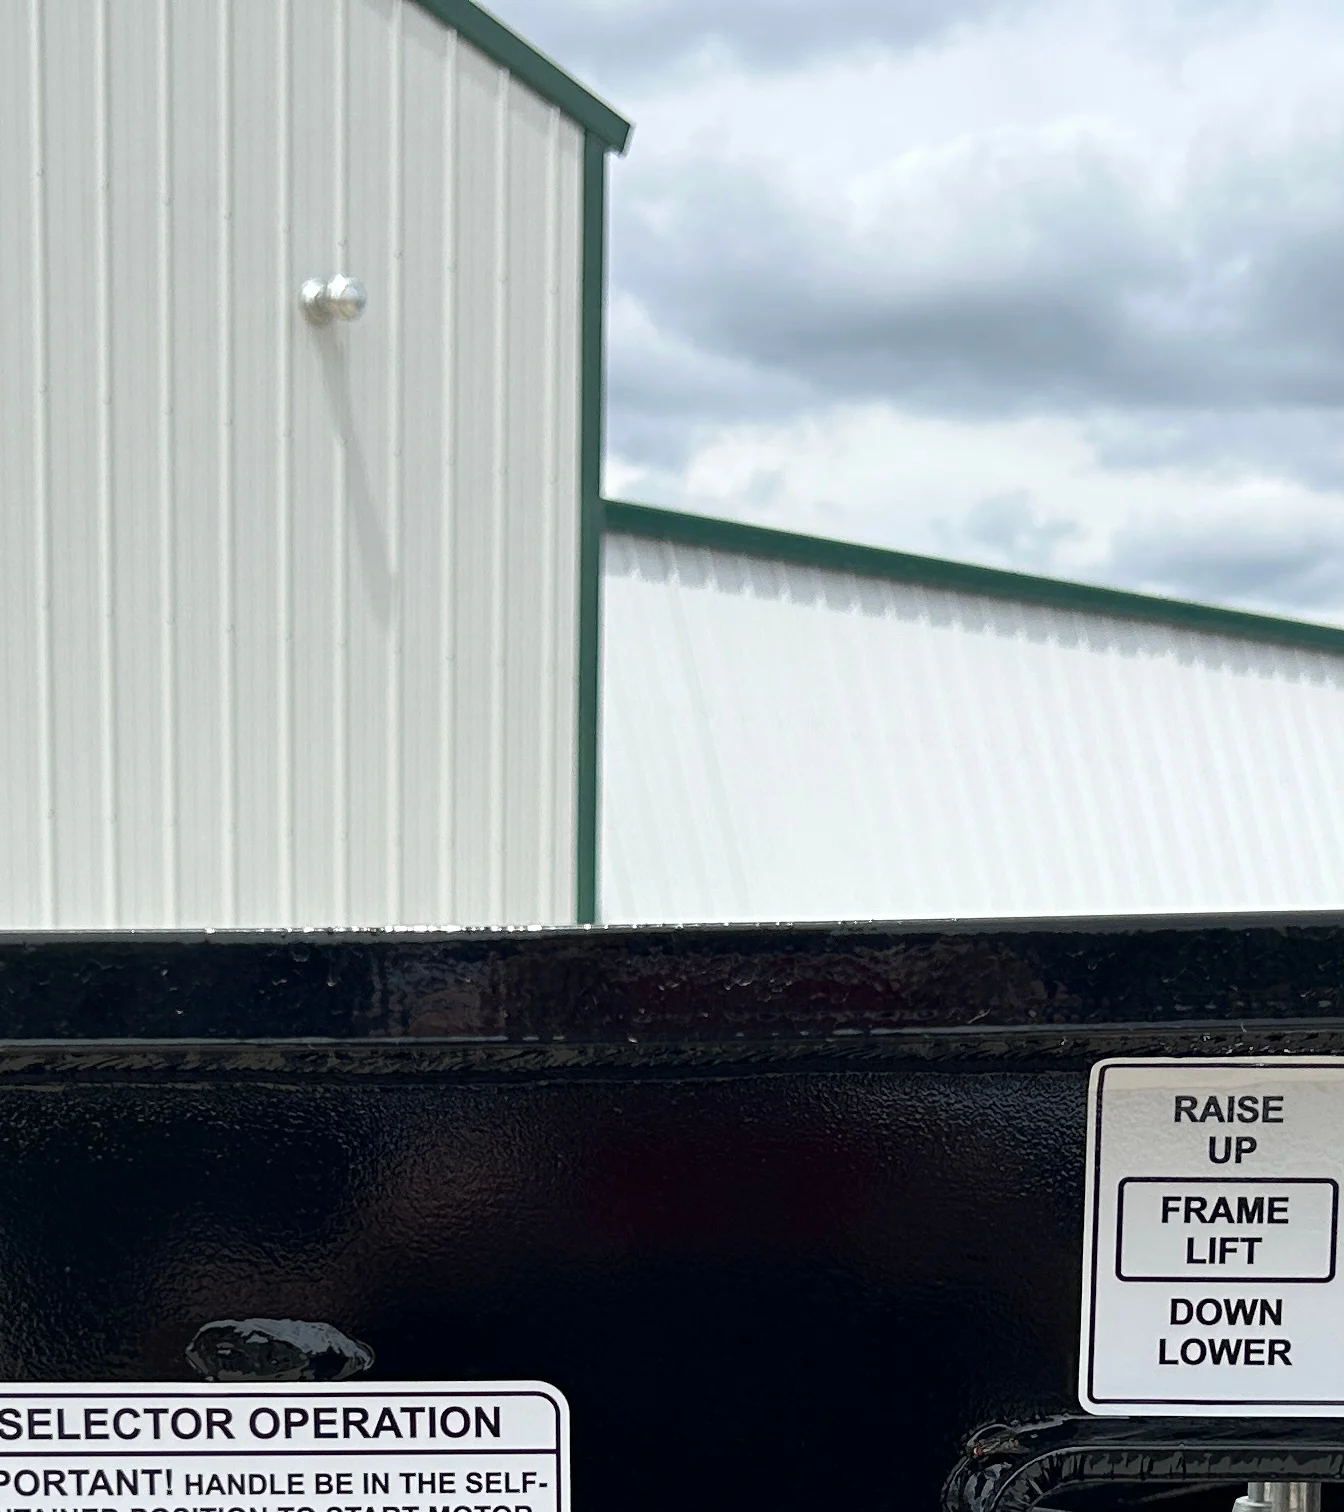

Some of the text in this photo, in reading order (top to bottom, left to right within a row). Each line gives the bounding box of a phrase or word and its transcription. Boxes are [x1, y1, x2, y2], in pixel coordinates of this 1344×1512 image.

[1175, 1096, 1283, 1123] RAISE
[1209, 1137, 1257, 1164] UP
[1162, 1197, 1289, 1224] FRAME
[1187, 1237, 1262, 1264] LIFT
[1170, 1299, 1282, 1325] DOWN
[1159, 1339, 1292, 1365] LOWER
[250, 1407, 500, 1439] OPERATION
[186, 1474, 304, 1495] HANDLE
[316, 1473, 353, 1494] BE
[364, 1473, 389, 1494] IN
[400, 1473, 455, 1493] THE
[466, 1472, 547, 1493] SELF-
